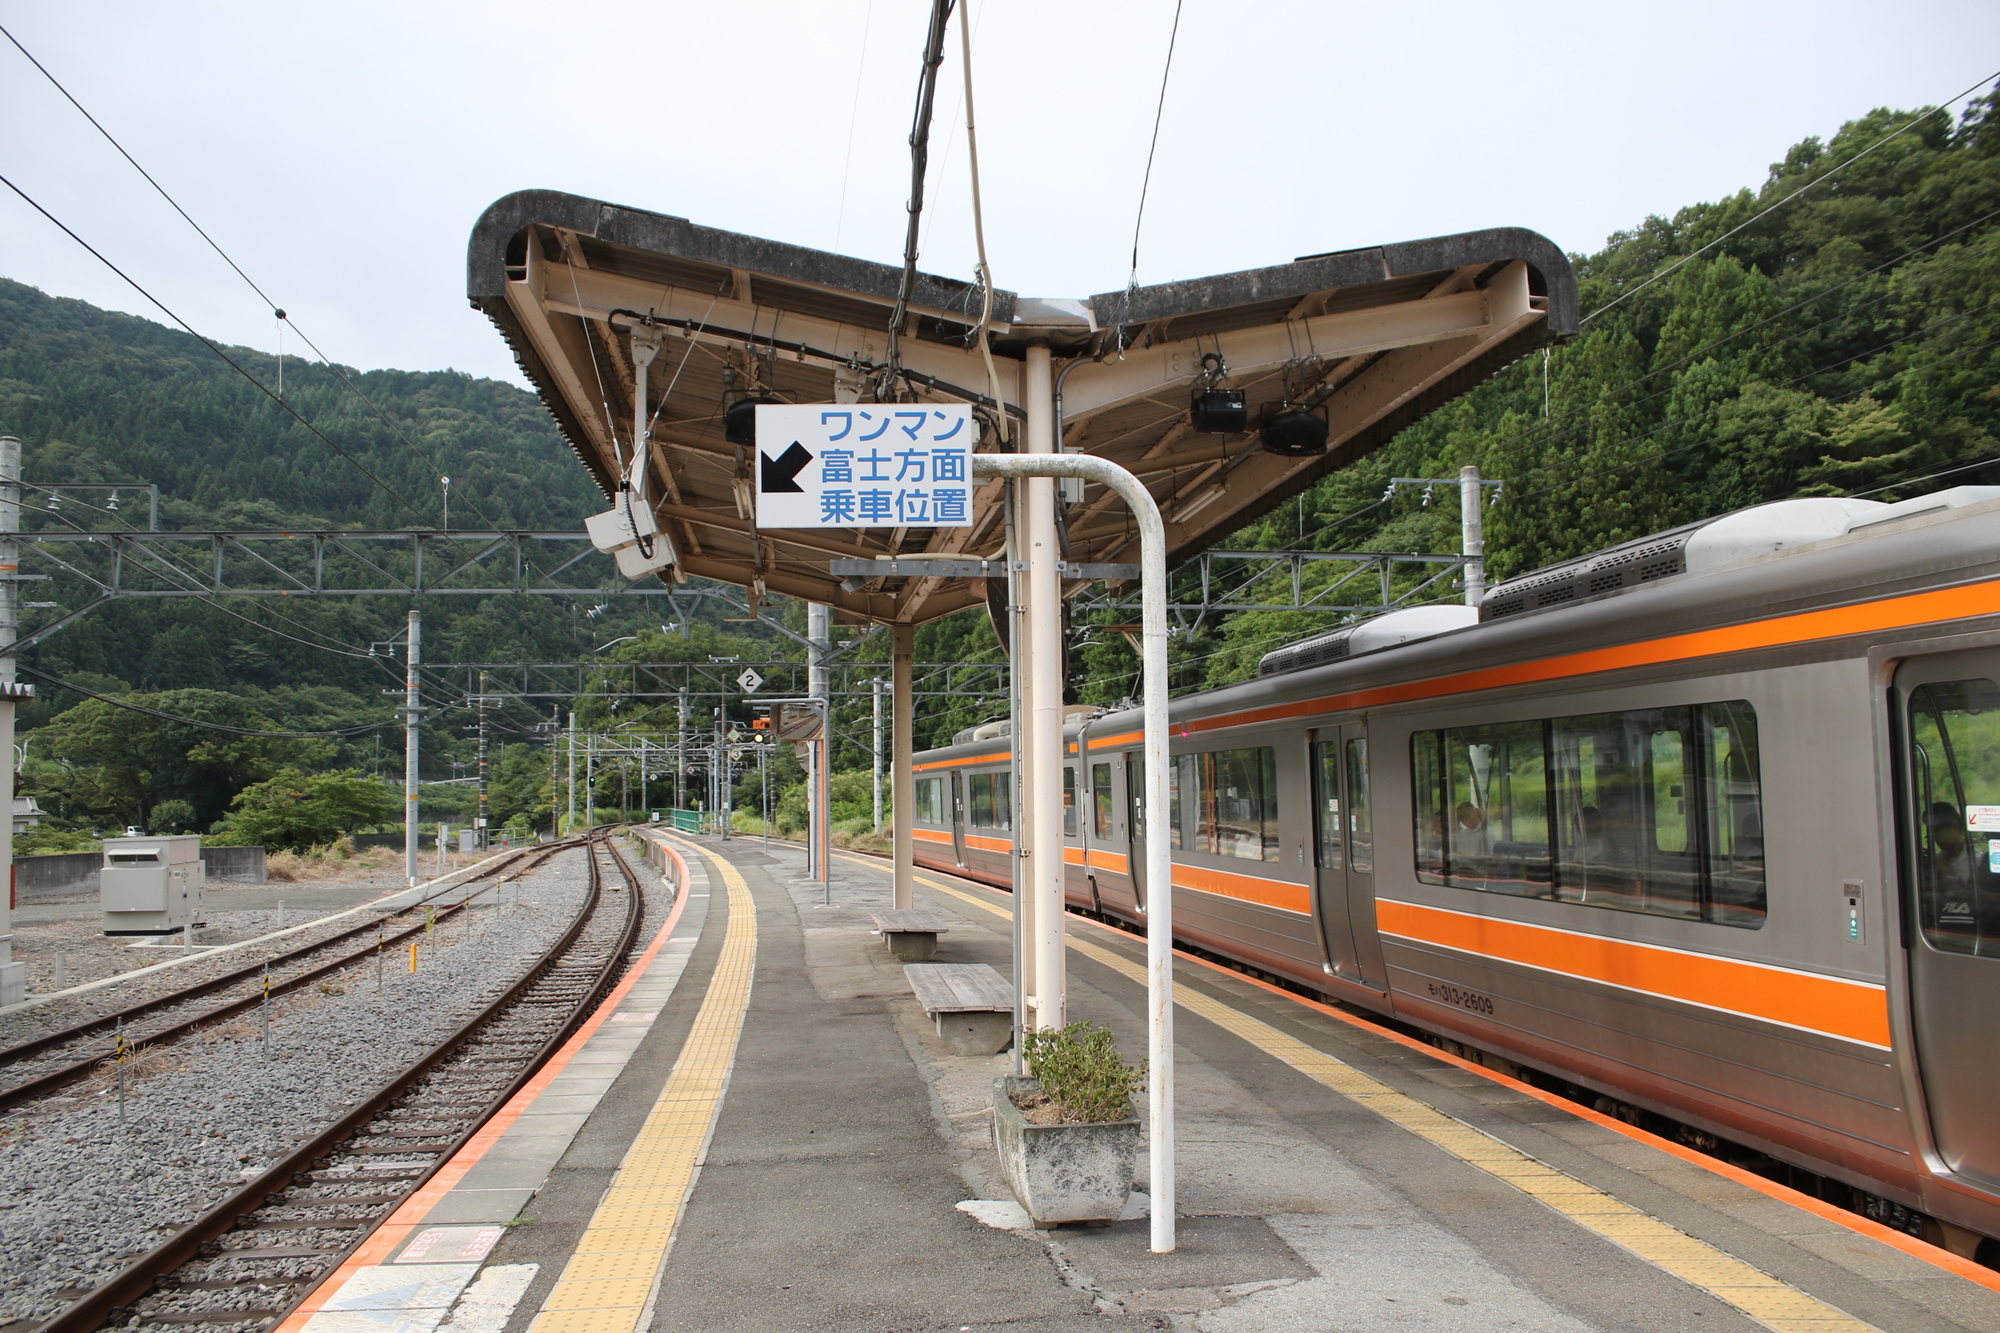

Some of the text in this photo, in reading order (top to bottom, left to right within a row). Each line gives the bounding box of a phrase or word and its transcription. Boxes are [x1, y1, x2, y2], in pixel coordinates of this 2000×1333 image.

[820, 410, 965, 442] ワンマン
[820, 448, 966, 483] 富士方面
[820, 488, 967, 523] 乗車位置
[745, 674, 755, 687] 2
[733, 750, 740, 758] 3
[1942, 902, 1970, 914] FILA
[1428, 983, 1494, 1015] モハ313-2609
